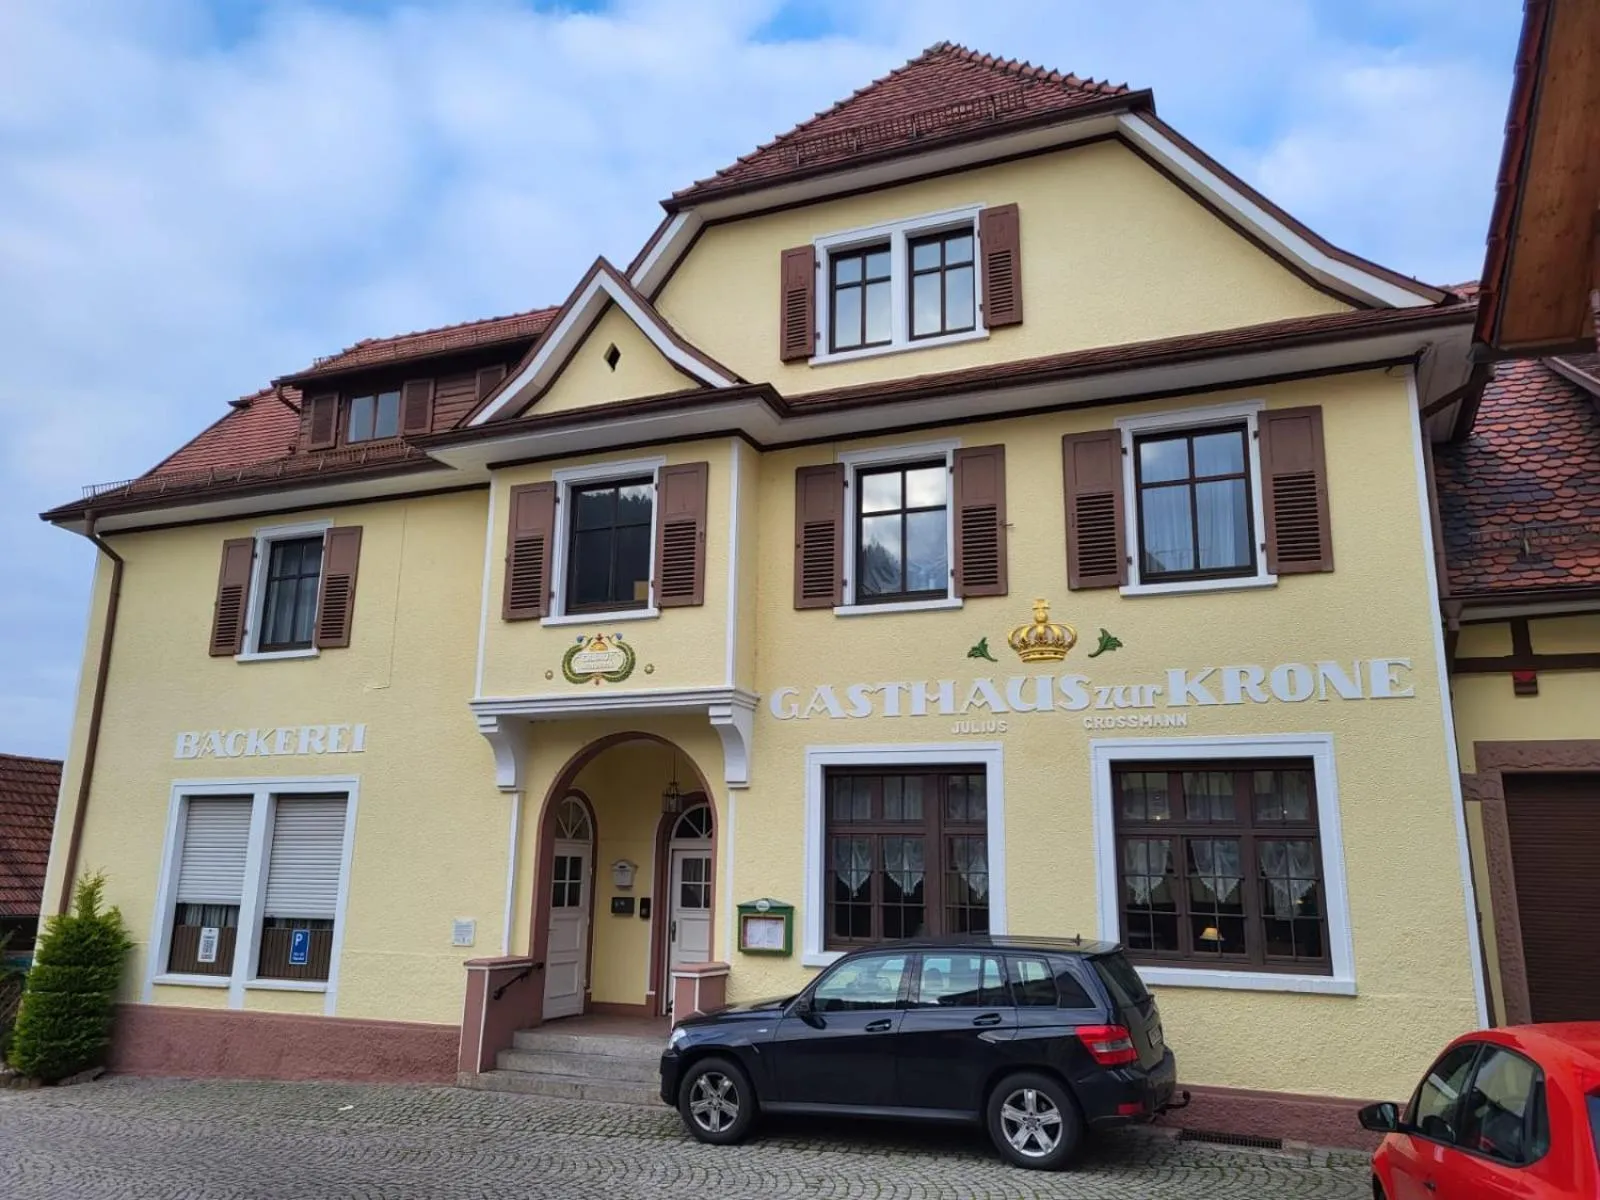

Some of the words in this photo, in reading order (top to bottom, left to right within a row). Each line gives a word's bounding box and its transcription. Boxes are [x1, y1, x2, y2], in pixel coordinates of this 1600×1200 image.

[769, 673, 1091, 720] GASTHAUS
[1093, 683, 1163, 709] zur
[1164, 656, 1415, 707] KRONE
[951, 720, 1008, 735] JULIUS
[1083, 712, 1188, 730] GROSSMANN
[294, 933, 303, 946] P
